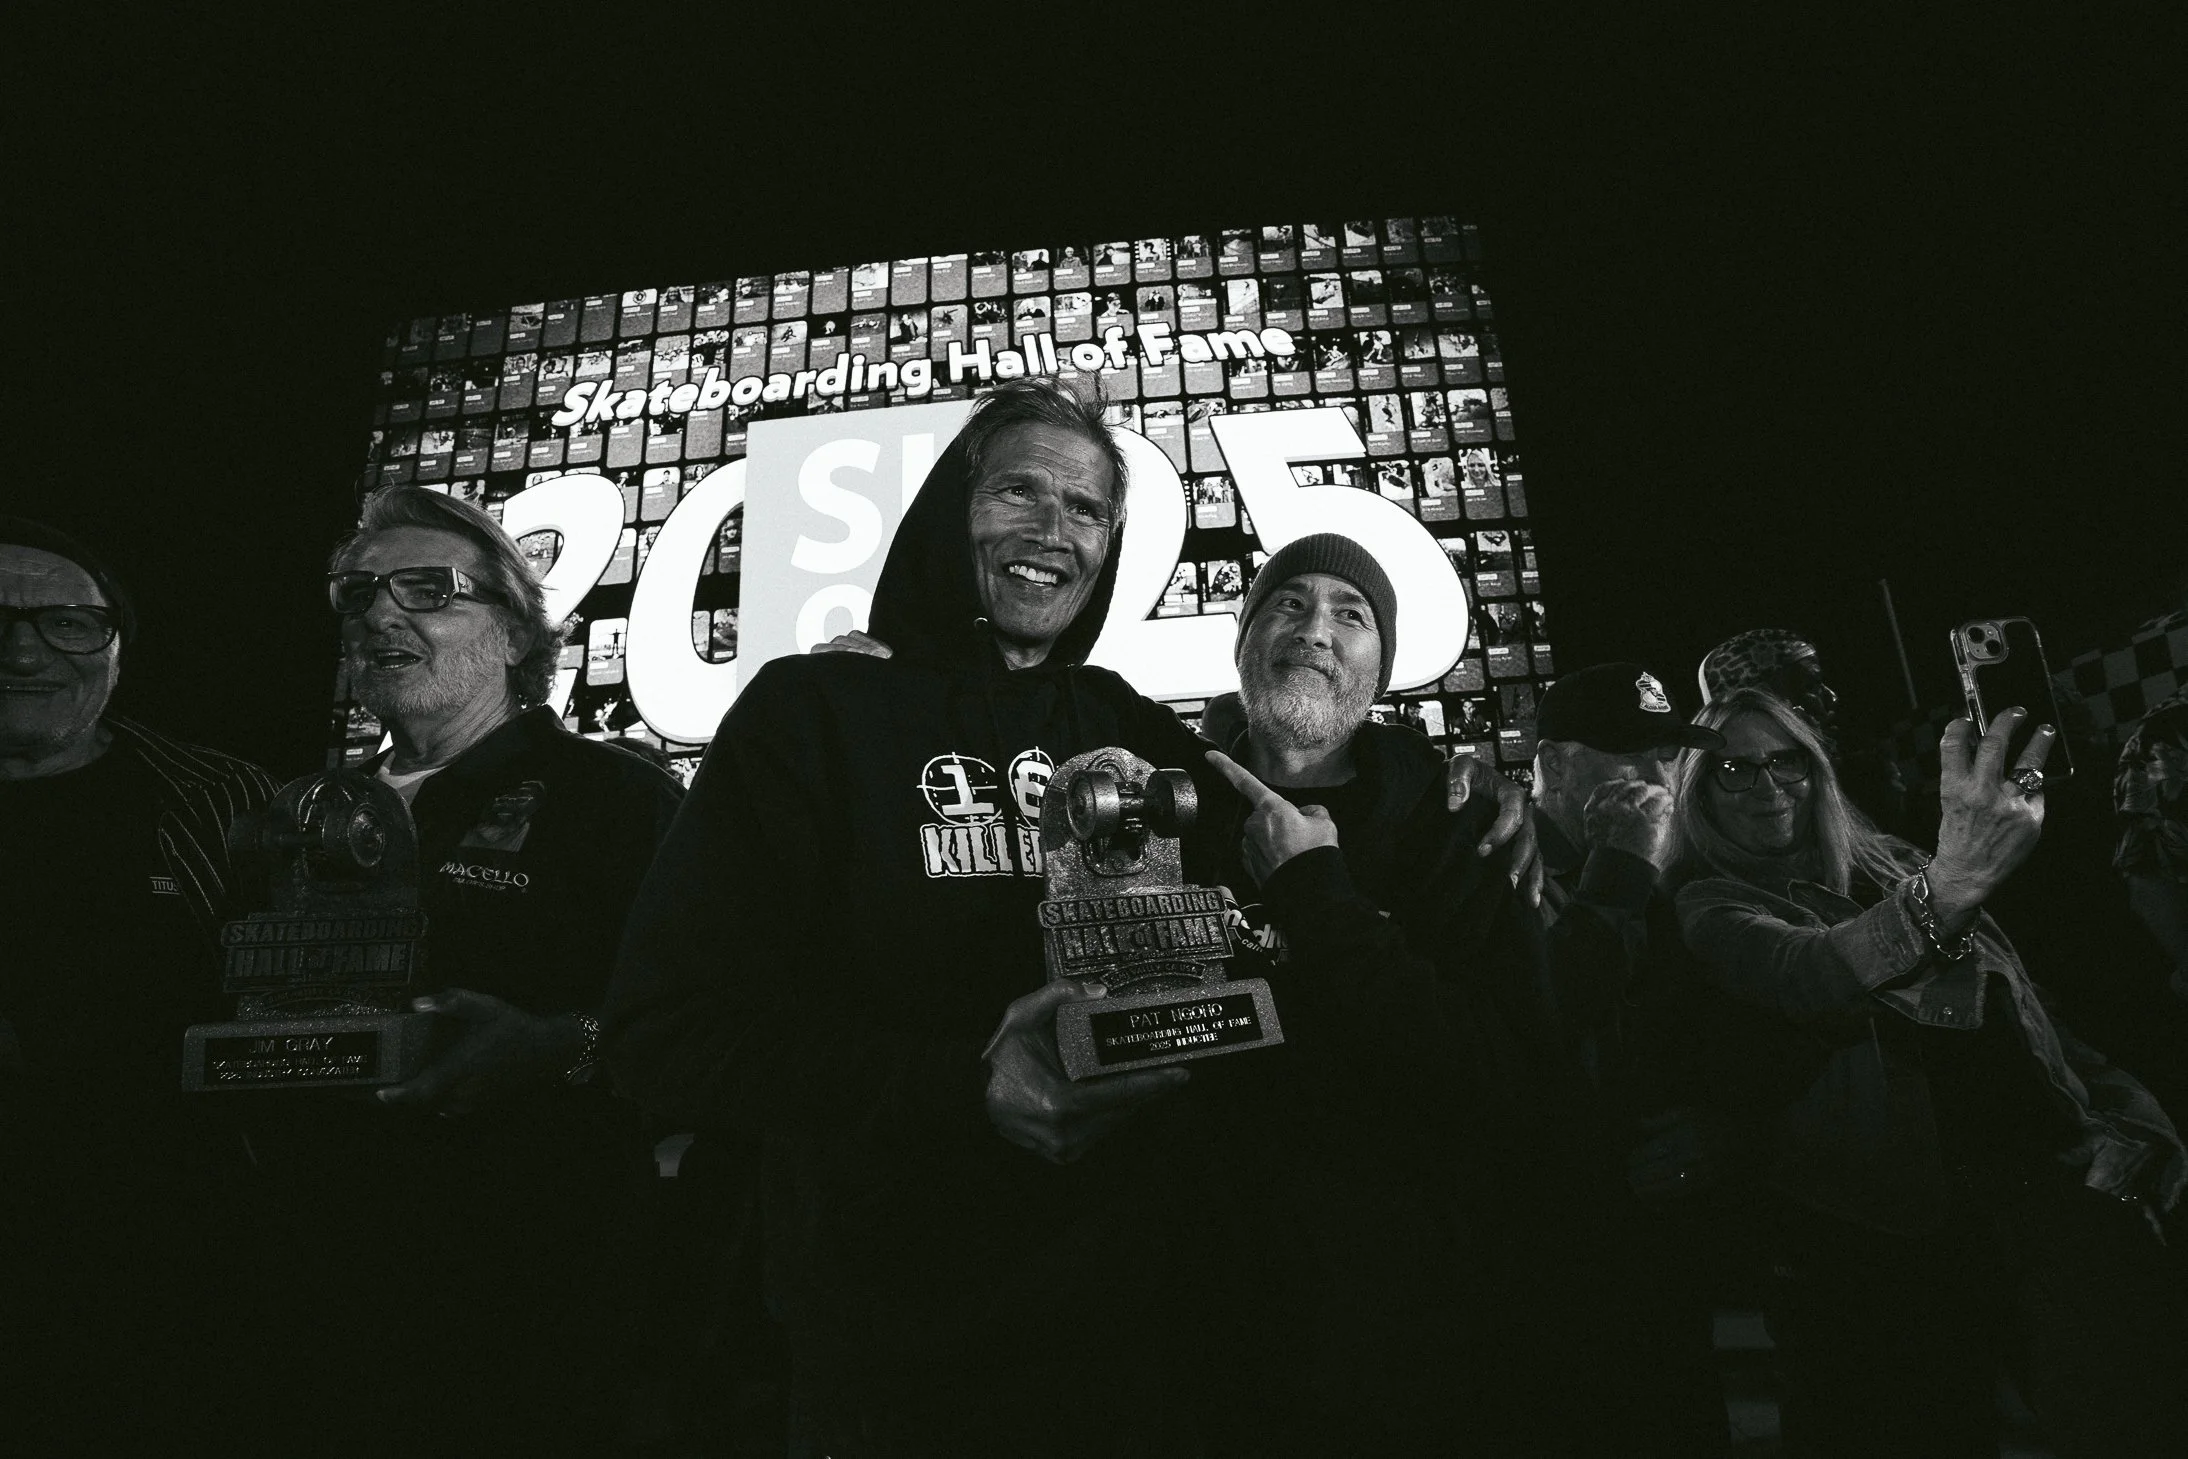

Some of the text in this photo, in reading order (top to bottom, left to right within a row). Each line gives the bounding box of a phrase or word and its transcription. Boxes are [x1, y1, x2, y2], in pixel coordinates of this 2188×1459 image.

[551, 322, 1296, 427] Skateboarding Hall of Fame
[1046, 892, 1221, 925] SKATEBOARDING
[229, 918, 418, 943] SKATEBOARDING
[1062, 922, 1131, 960] HALL
[1154, 915, 1223, 950] FAME
[1130, 1003, 1223, 1028] PAT NGOHO
[250, 1036, 334, 1053] JIM GRAY
[1105, 1016, 1252, 1047] SKATEBOARDING HALL OF FAME
